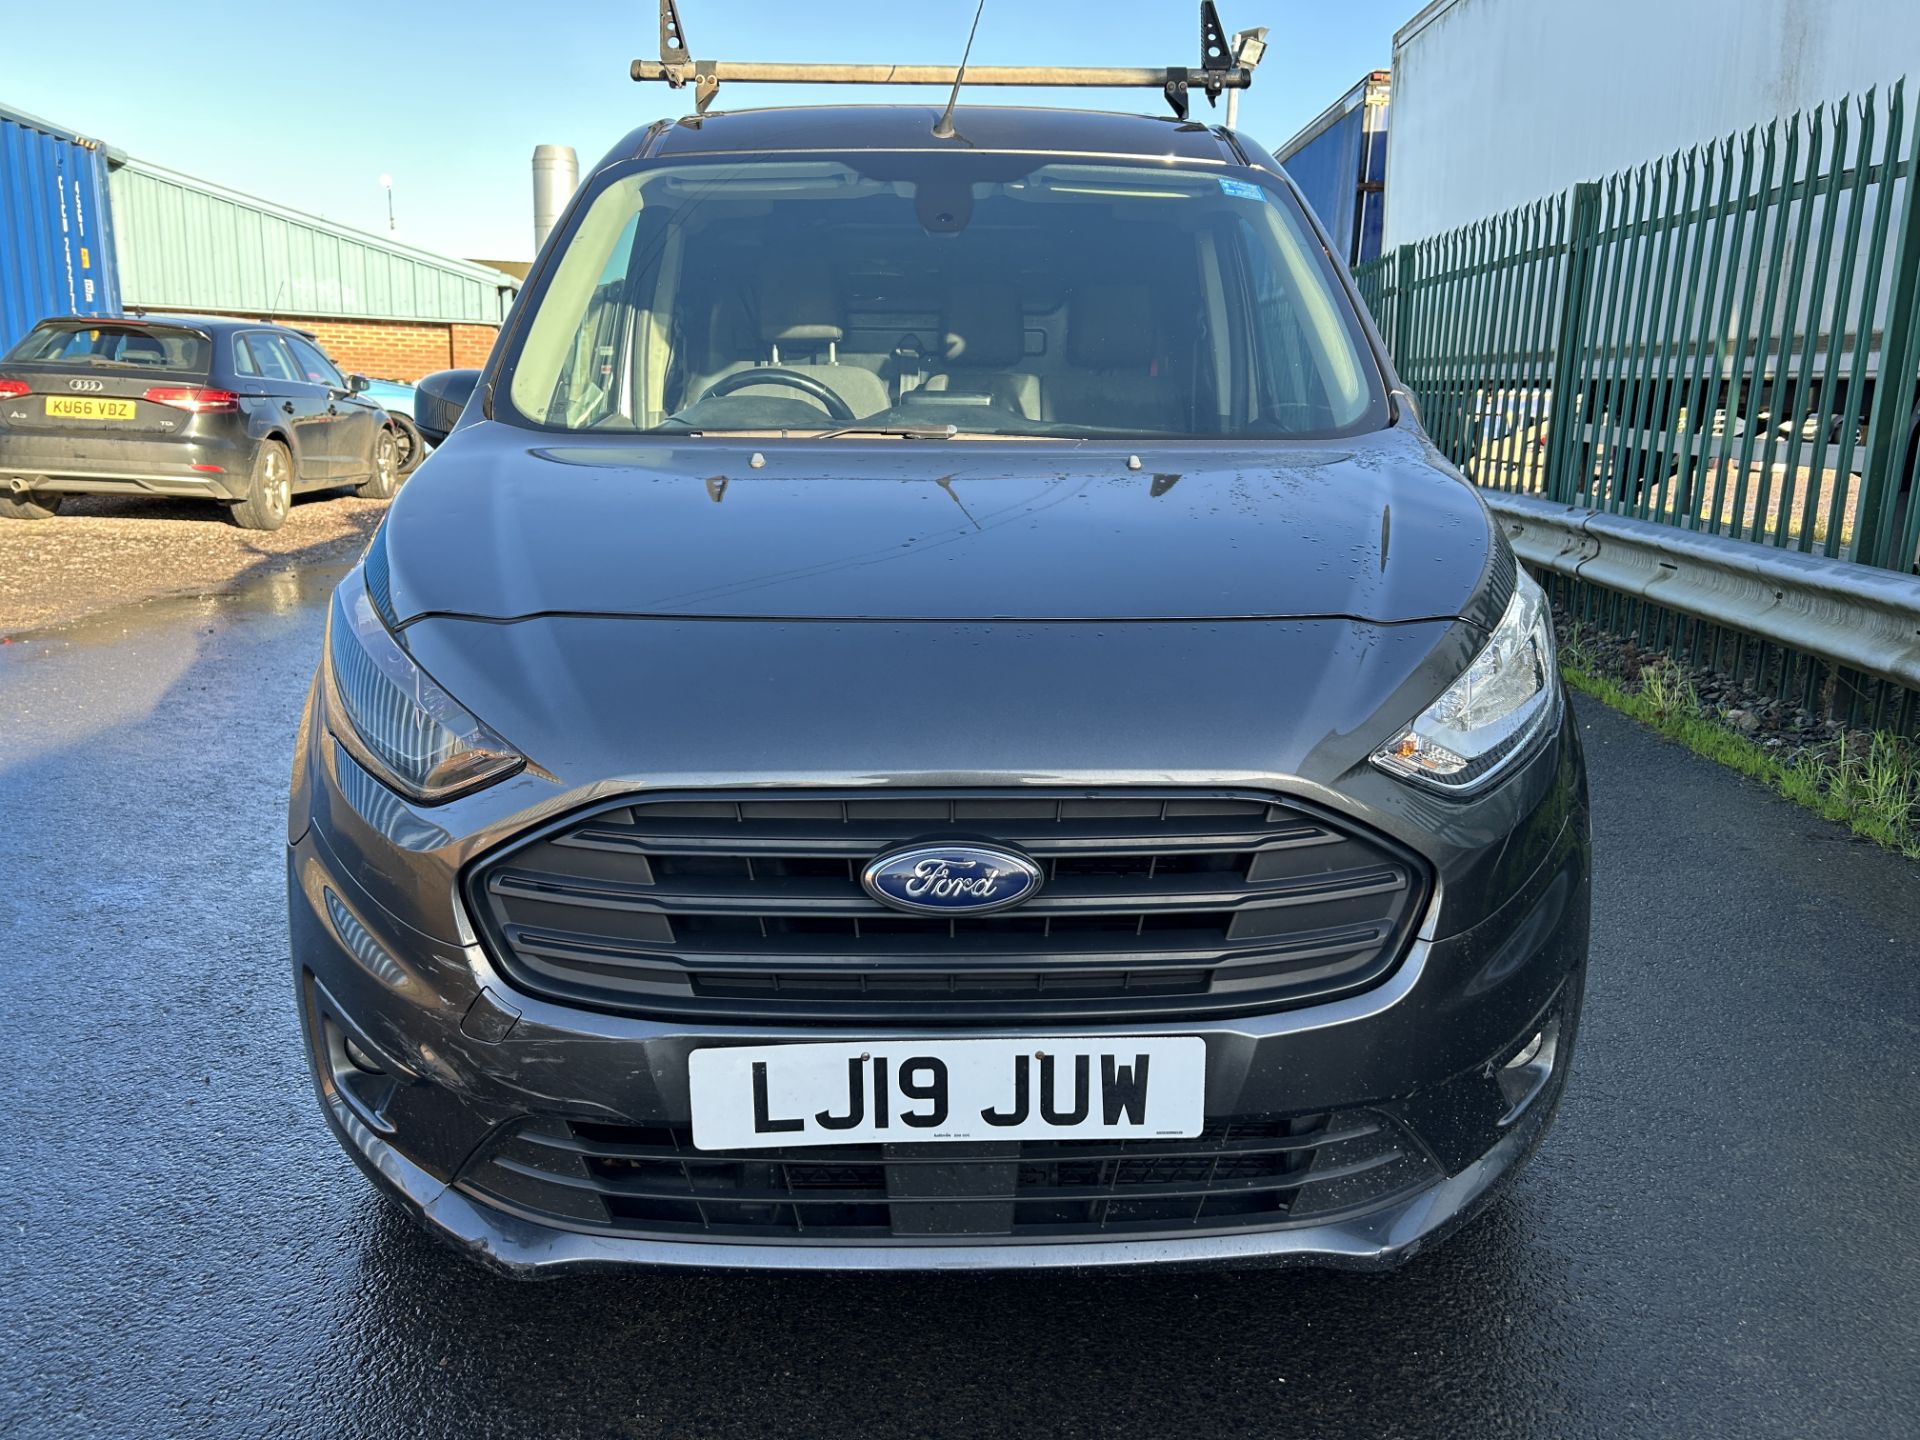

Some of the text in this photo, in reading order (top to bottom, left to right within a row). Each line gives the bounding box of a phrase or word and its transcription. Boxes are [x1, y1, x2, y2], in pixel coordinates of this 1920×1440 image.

[53, 400, 128, 416] KU66 VDZ
[906, 859, 999, 897] Ford
[752, 1054, 1150, 1133] LJ19 JUW
